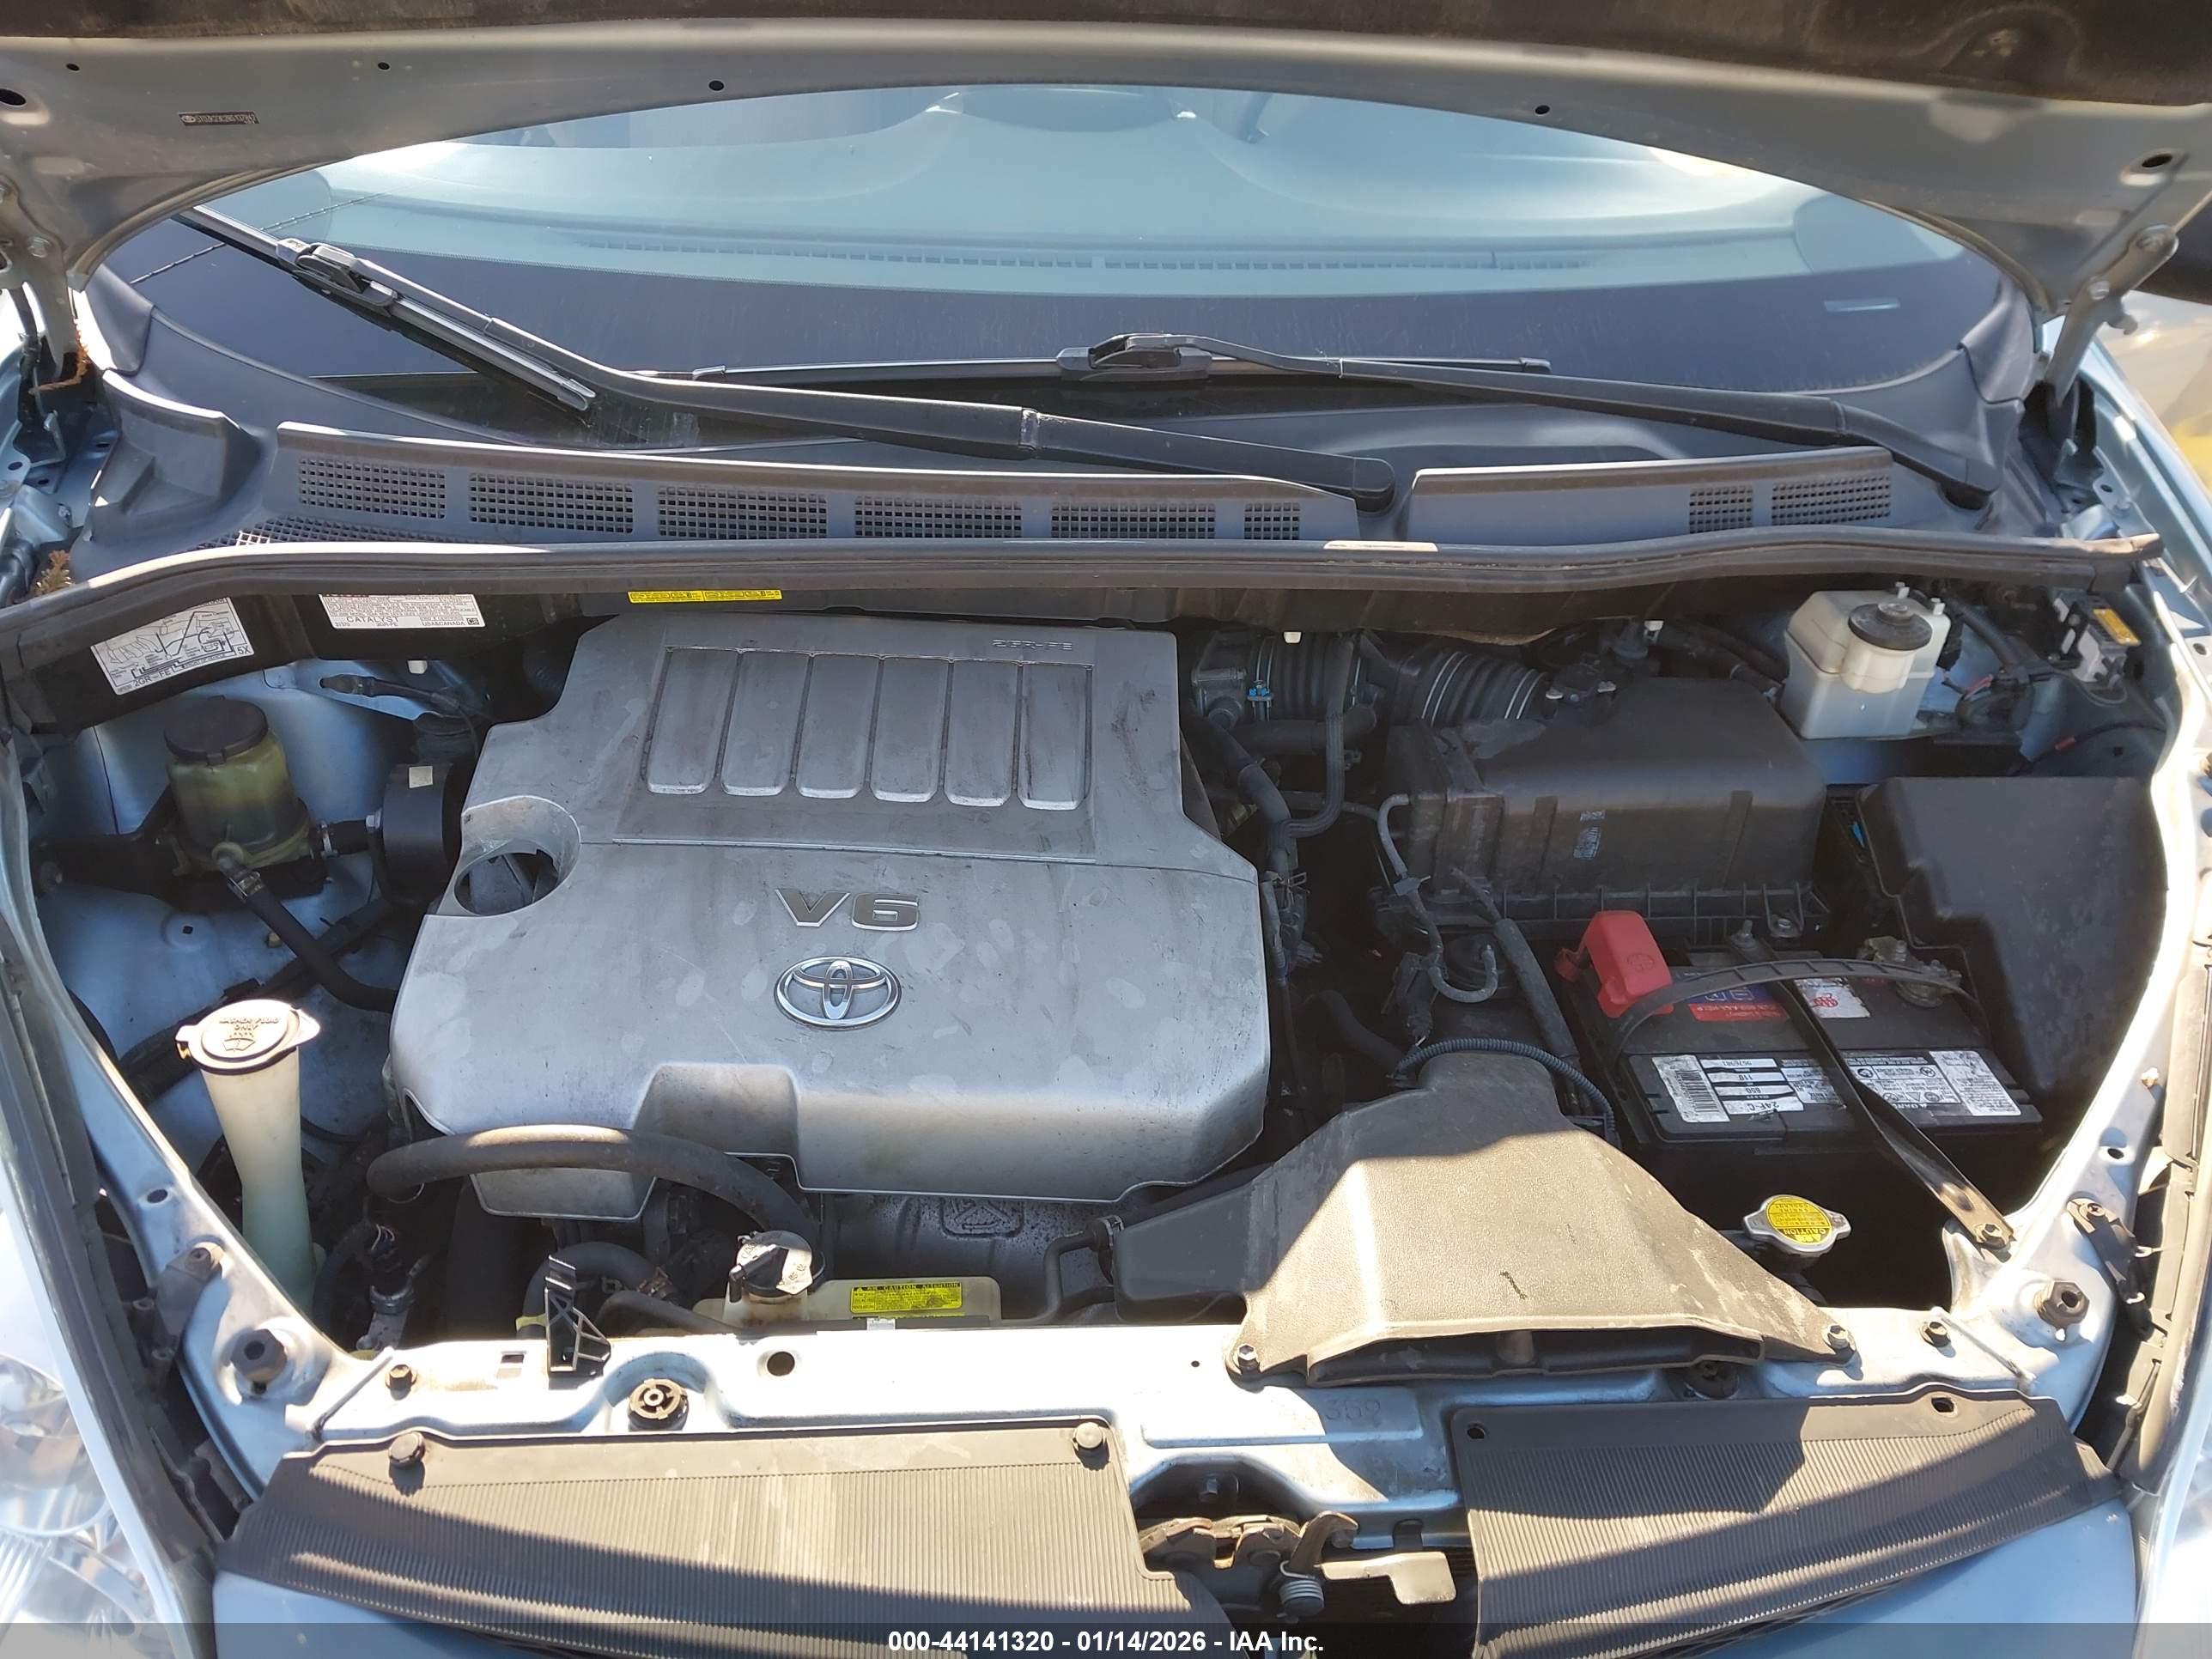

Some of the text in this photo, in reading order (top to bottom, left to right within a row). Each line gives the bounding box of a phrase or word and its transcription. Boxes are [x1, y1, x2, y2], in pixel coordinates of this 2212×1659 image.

[237, 645, 252, 655] 5X
[134, 669, 171, 686] 2GR-FE
[775, 889, 921, 932] V6
